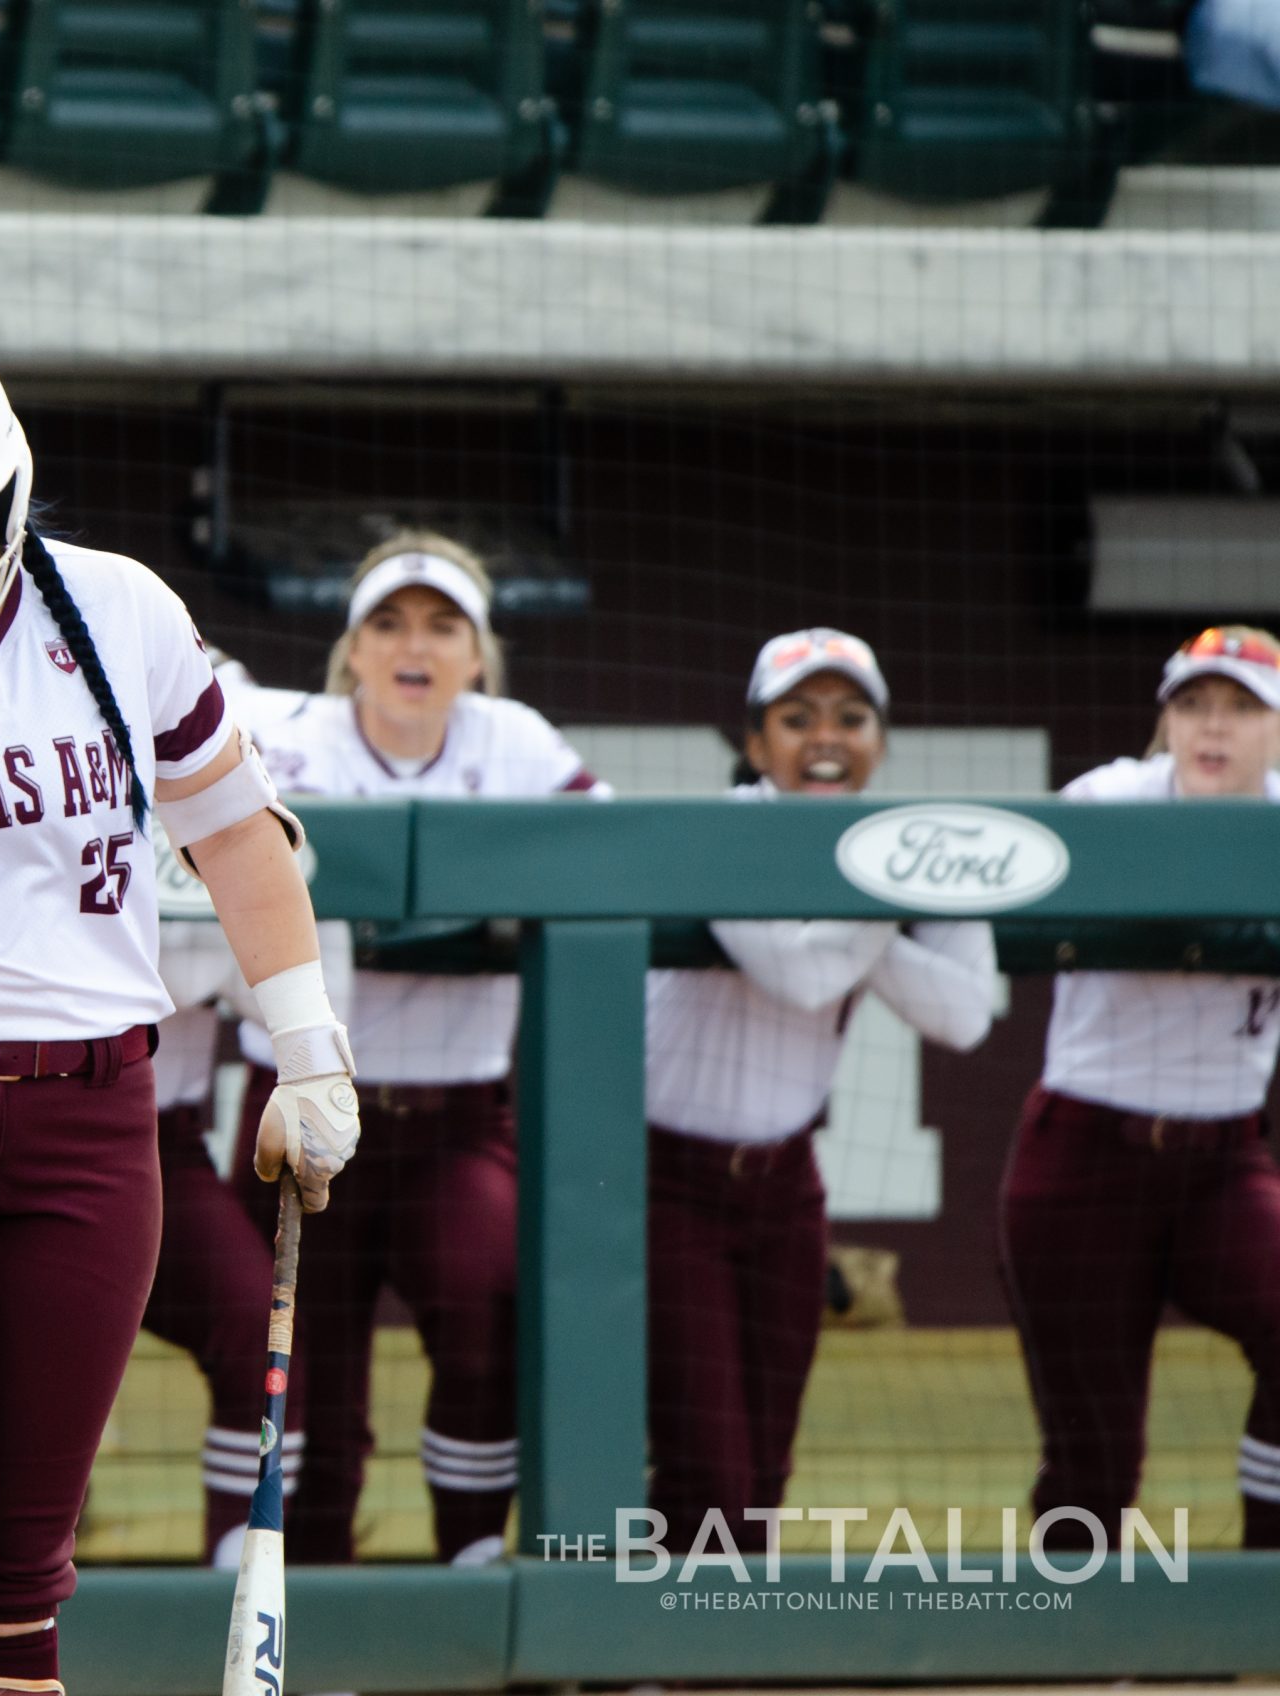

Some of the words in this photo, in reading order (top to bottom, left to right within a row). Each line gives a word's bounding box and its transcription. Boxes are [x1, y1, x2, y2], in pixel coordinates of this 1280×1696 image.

[52, 725, 132, 818] A&M
[79, 832, 134, 914] 25
[886, 819, 1018, 887] Ford
